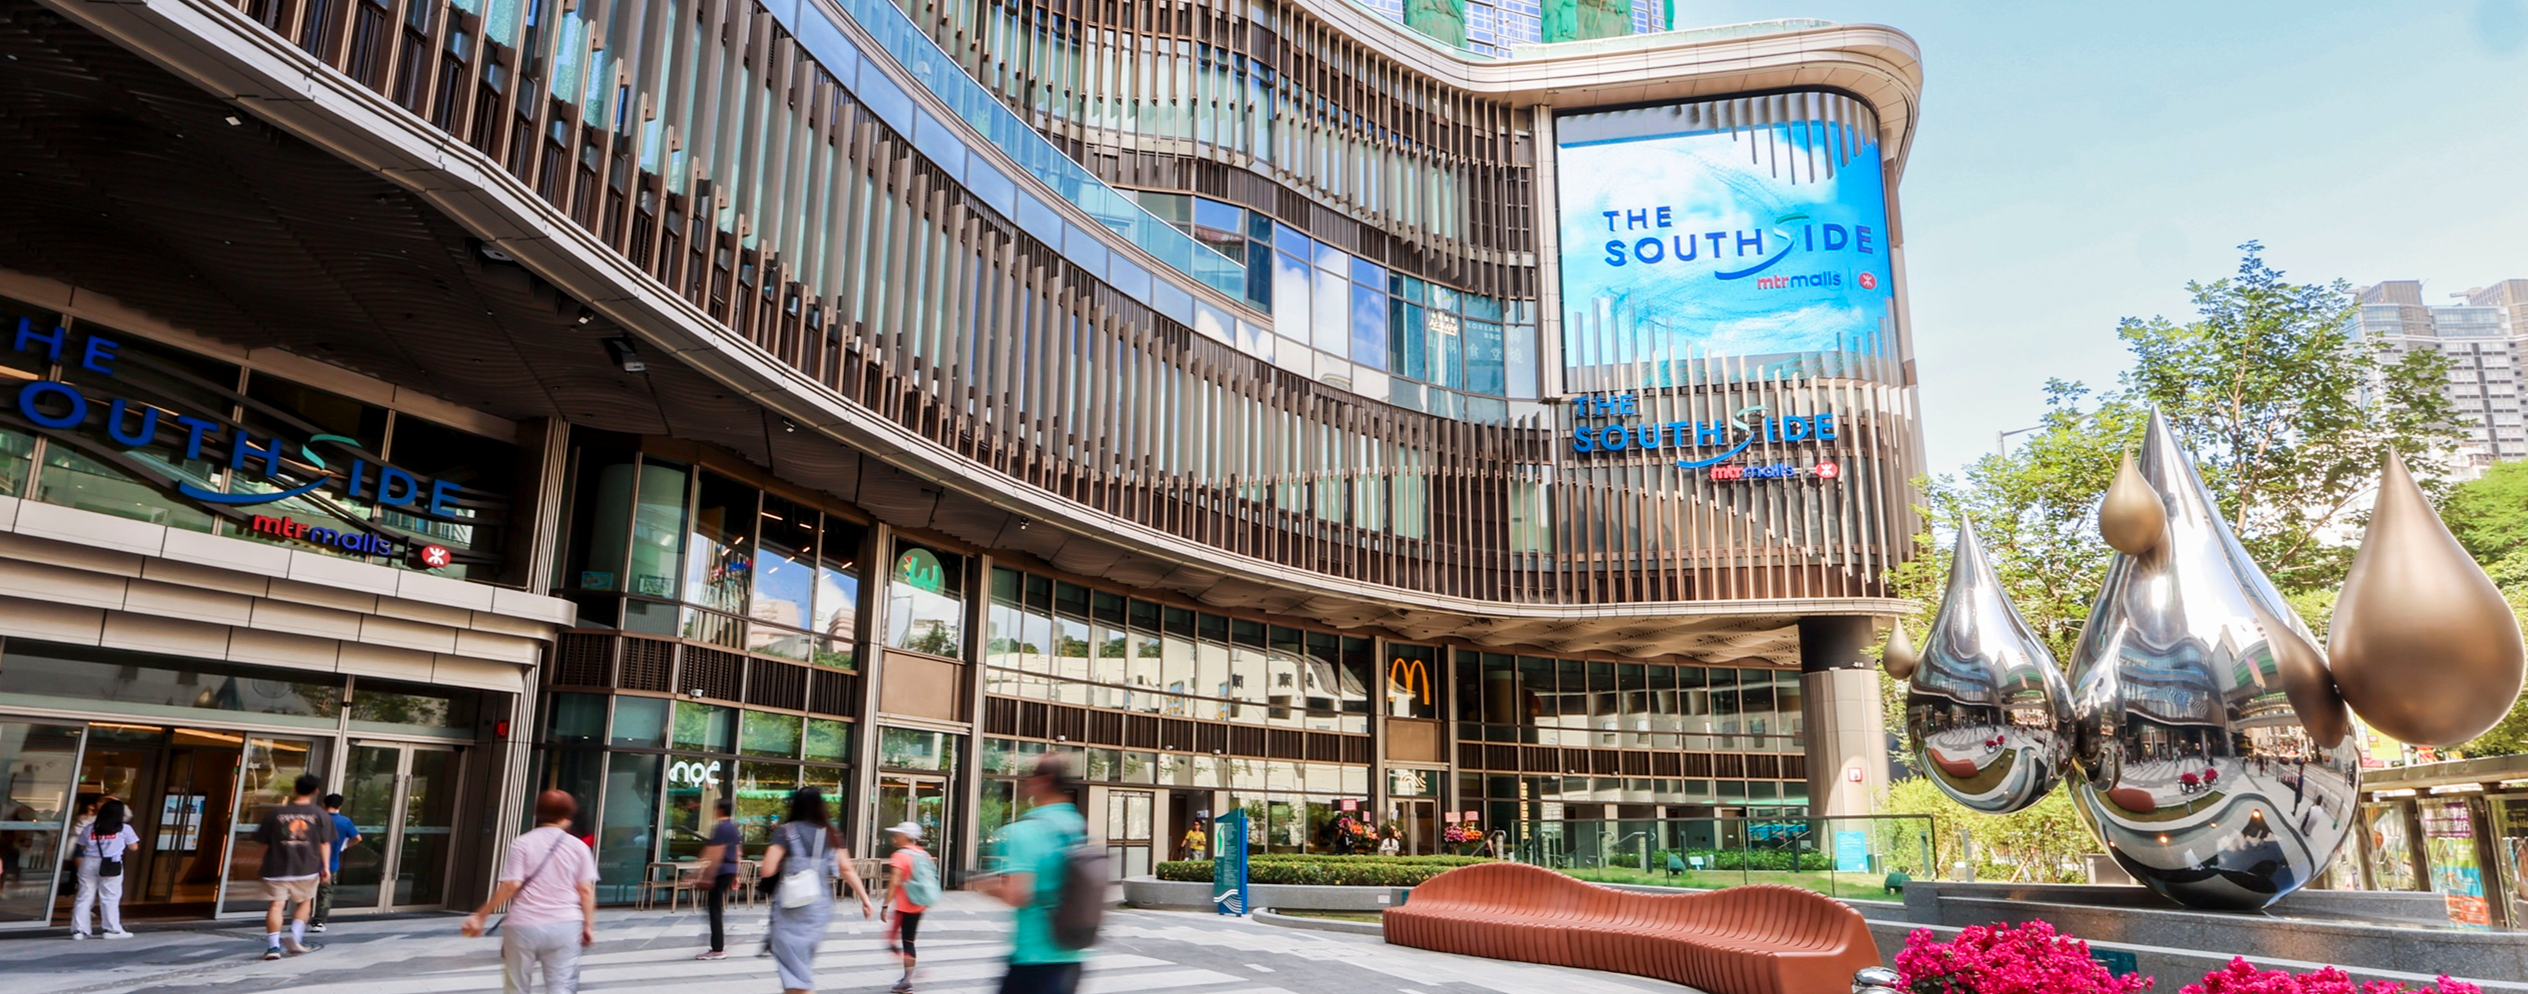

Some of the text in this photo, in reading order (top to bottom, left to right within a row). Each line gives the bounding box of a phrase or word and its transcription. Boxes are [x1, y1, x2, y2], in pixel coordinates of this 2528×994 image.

[1603, 206, 1672, 232] THE
[1466, 322, 1500, 334] KOREAN
[0, 309, 119, 375] HE
[1573, 394, 1635, 416] THE
